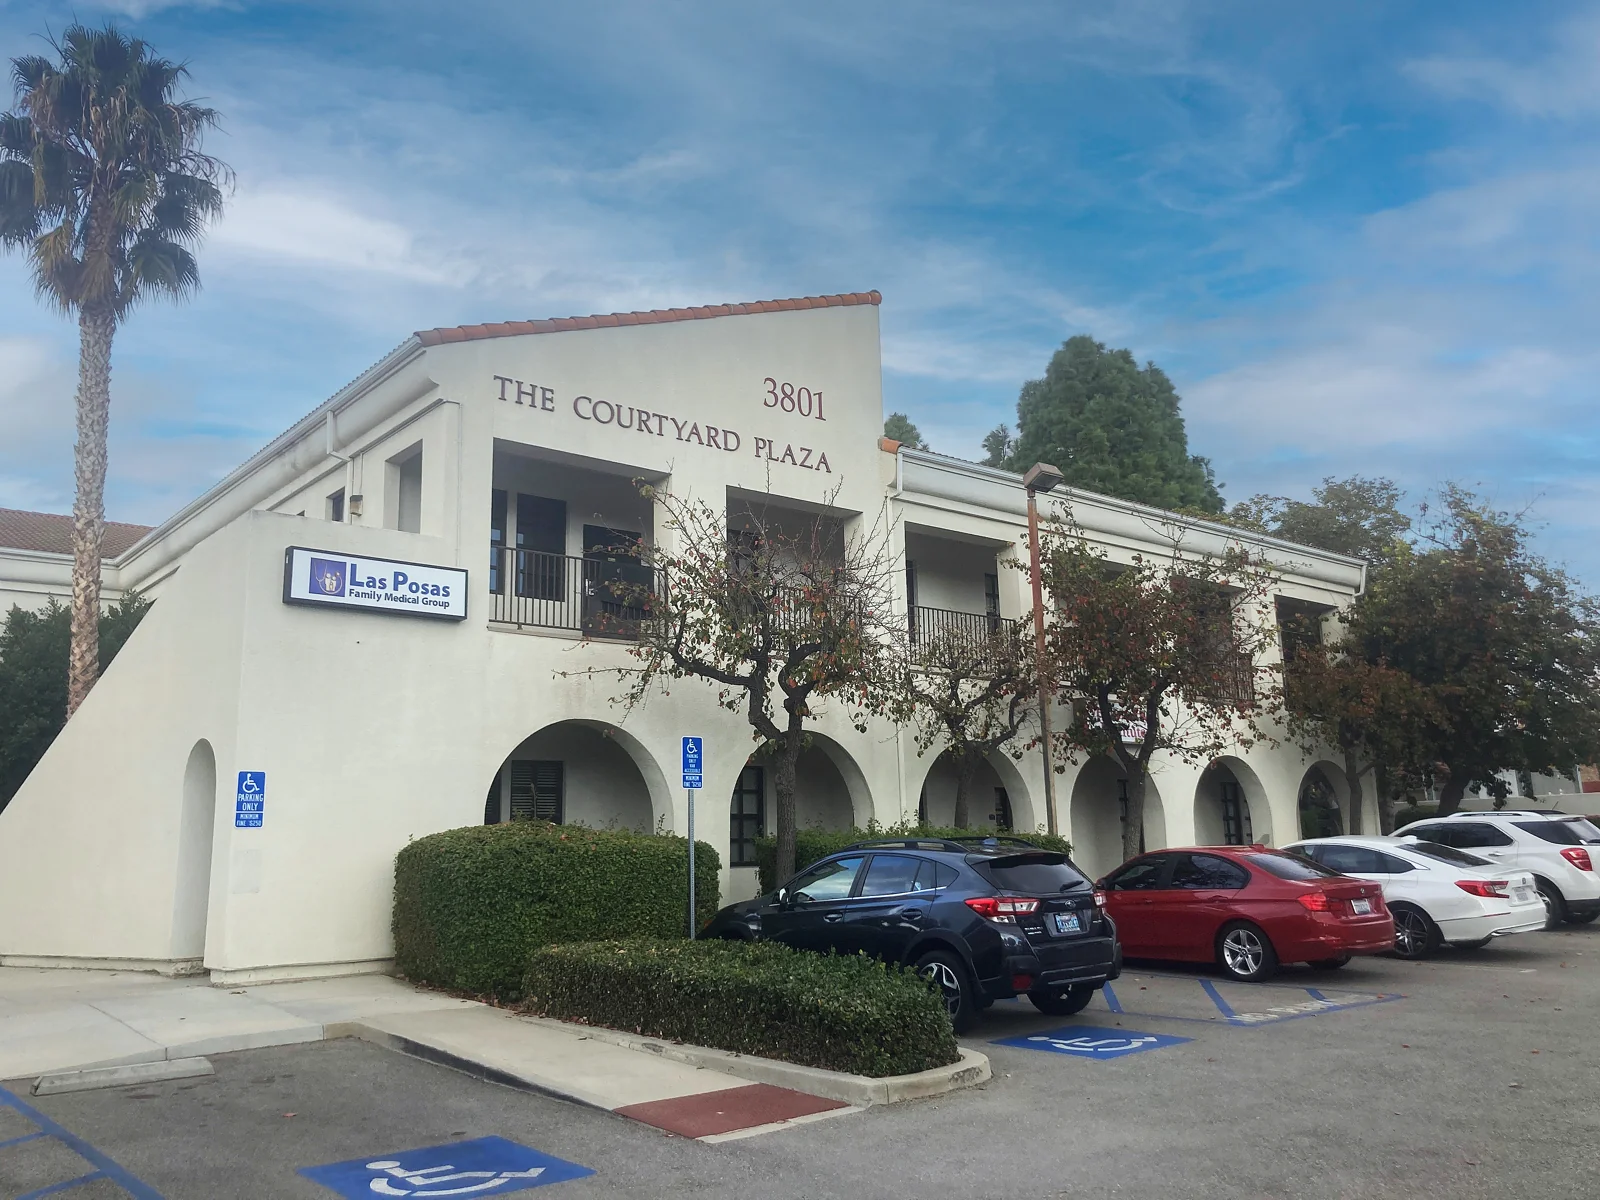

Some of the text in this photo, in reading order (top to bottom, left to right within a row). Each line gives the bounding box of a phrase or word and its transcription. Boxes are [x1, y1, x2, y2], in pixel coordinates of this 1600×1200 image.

[763, 377, 827, 422] 3801
[493, 374, 832, 474] THE COURTYARD PLAZA
[350, 563, 451, 598] Las Posas
[349, 588, 450, 609] Family Medical Group
[237, 793, 264, 802] PARKING
[242, 802, 259, 811] ONLY
